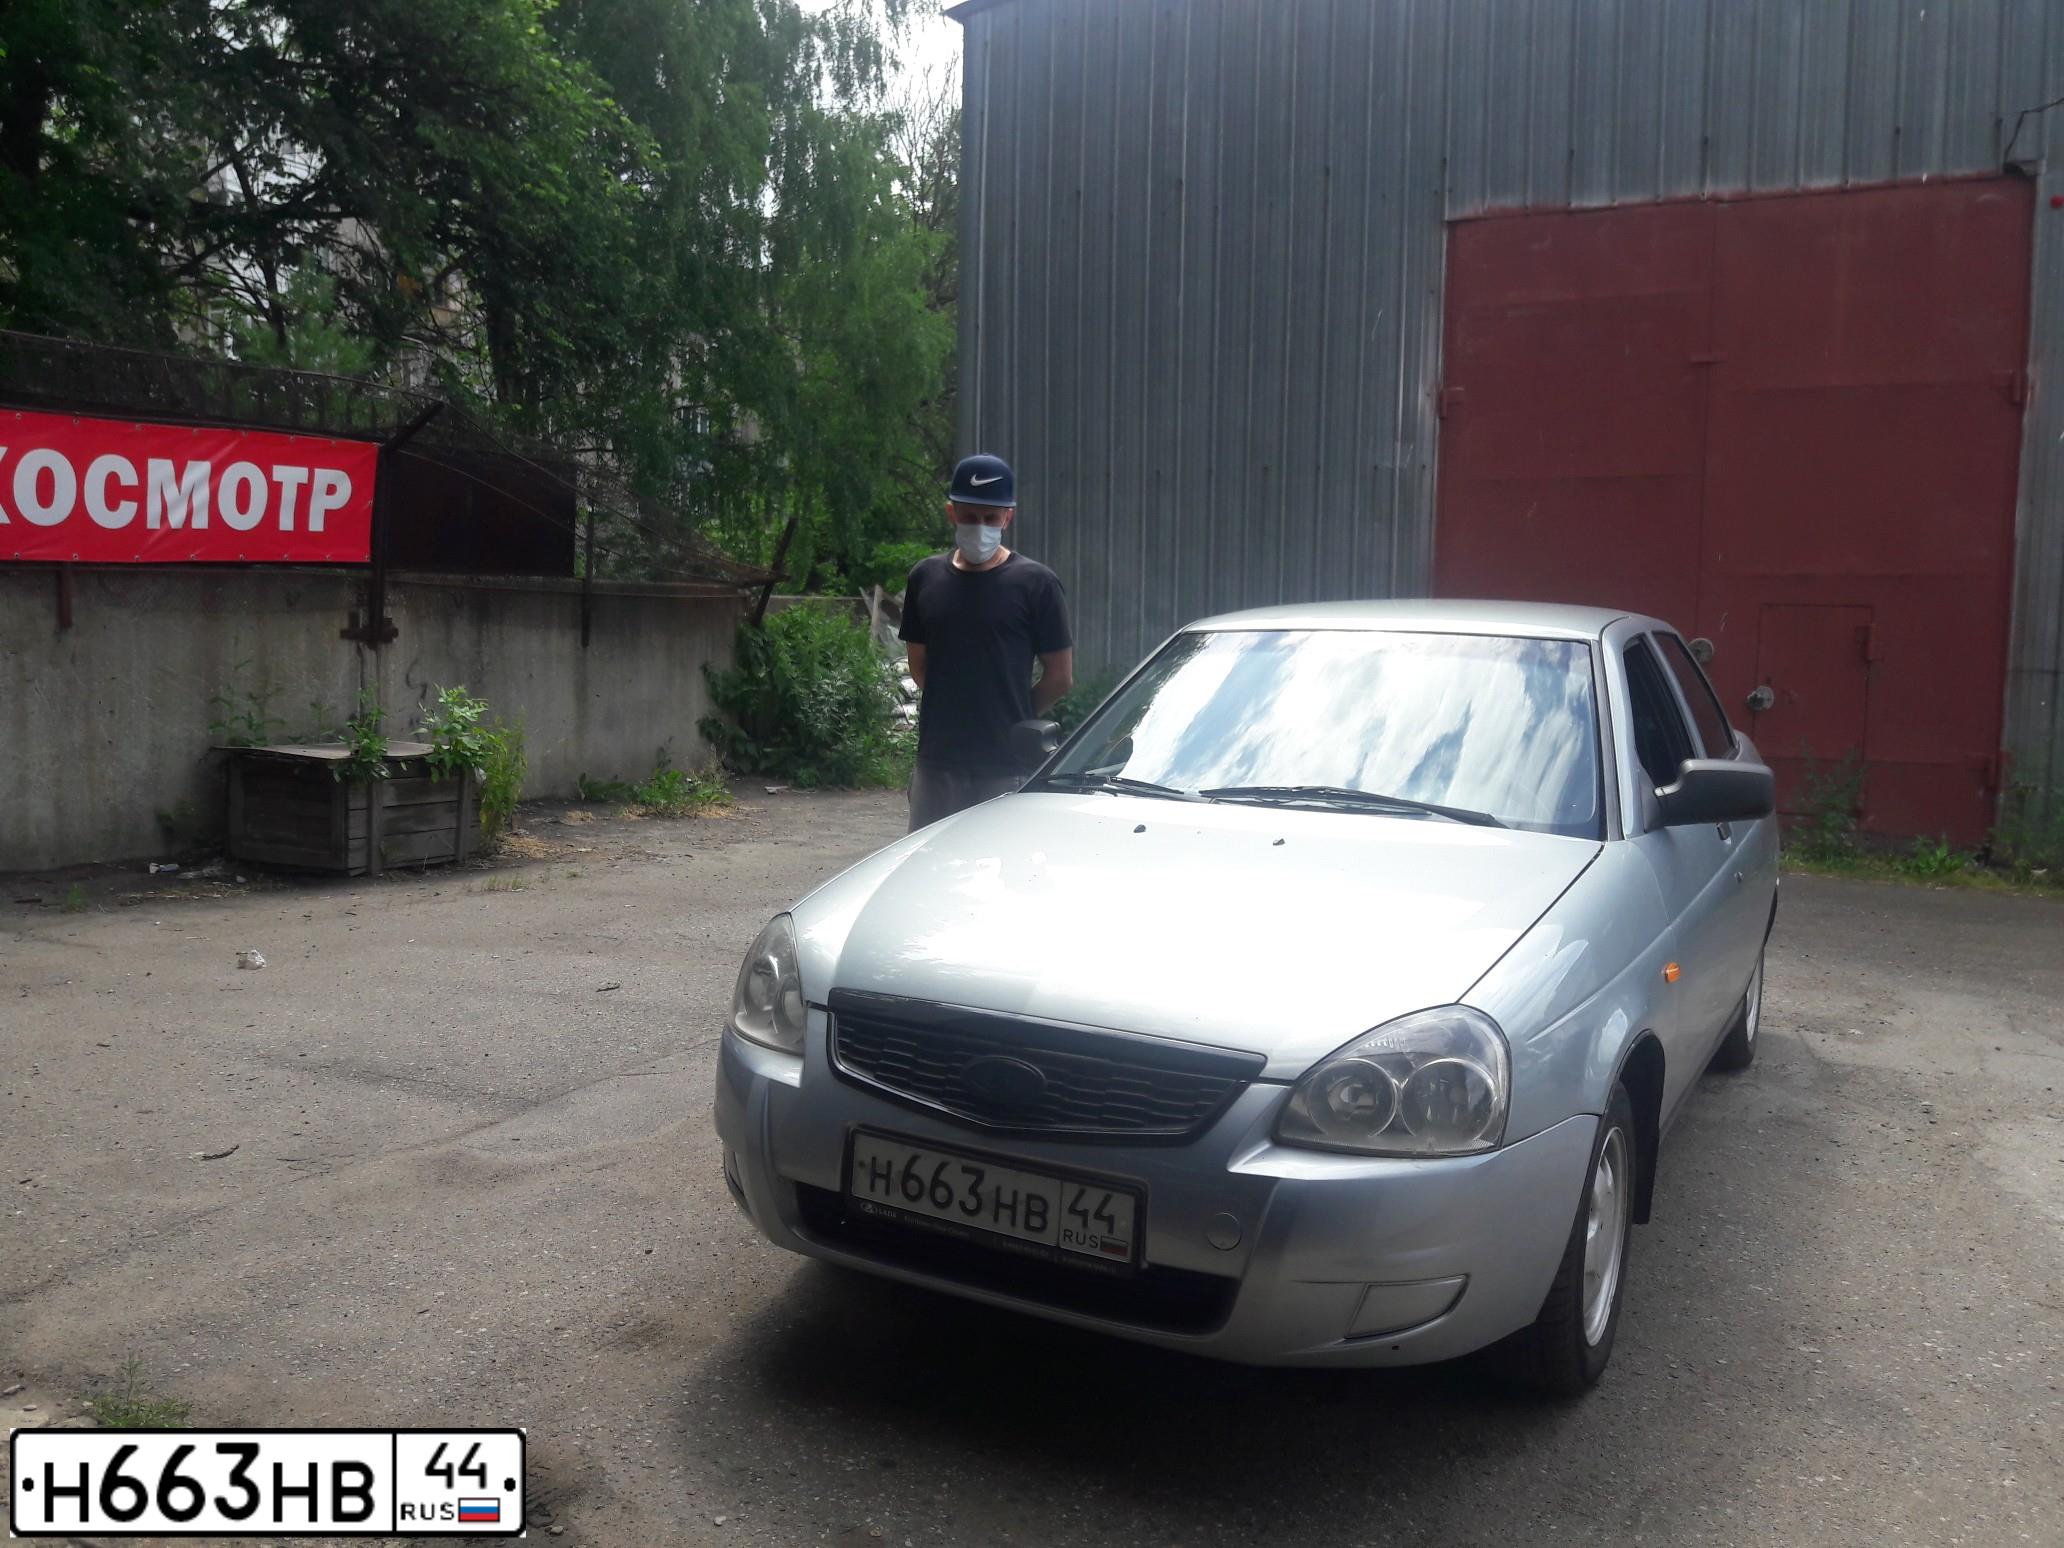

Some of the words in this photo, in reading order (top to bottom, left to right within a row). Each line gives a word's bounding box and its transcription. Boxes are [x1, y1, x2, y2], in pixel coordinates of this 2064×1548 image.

[0, 446, 352, 532] ОСМОТР
[1067, 1187, 1116, 1235] 44
[1063, 1228, 1099, 1249] RUS
